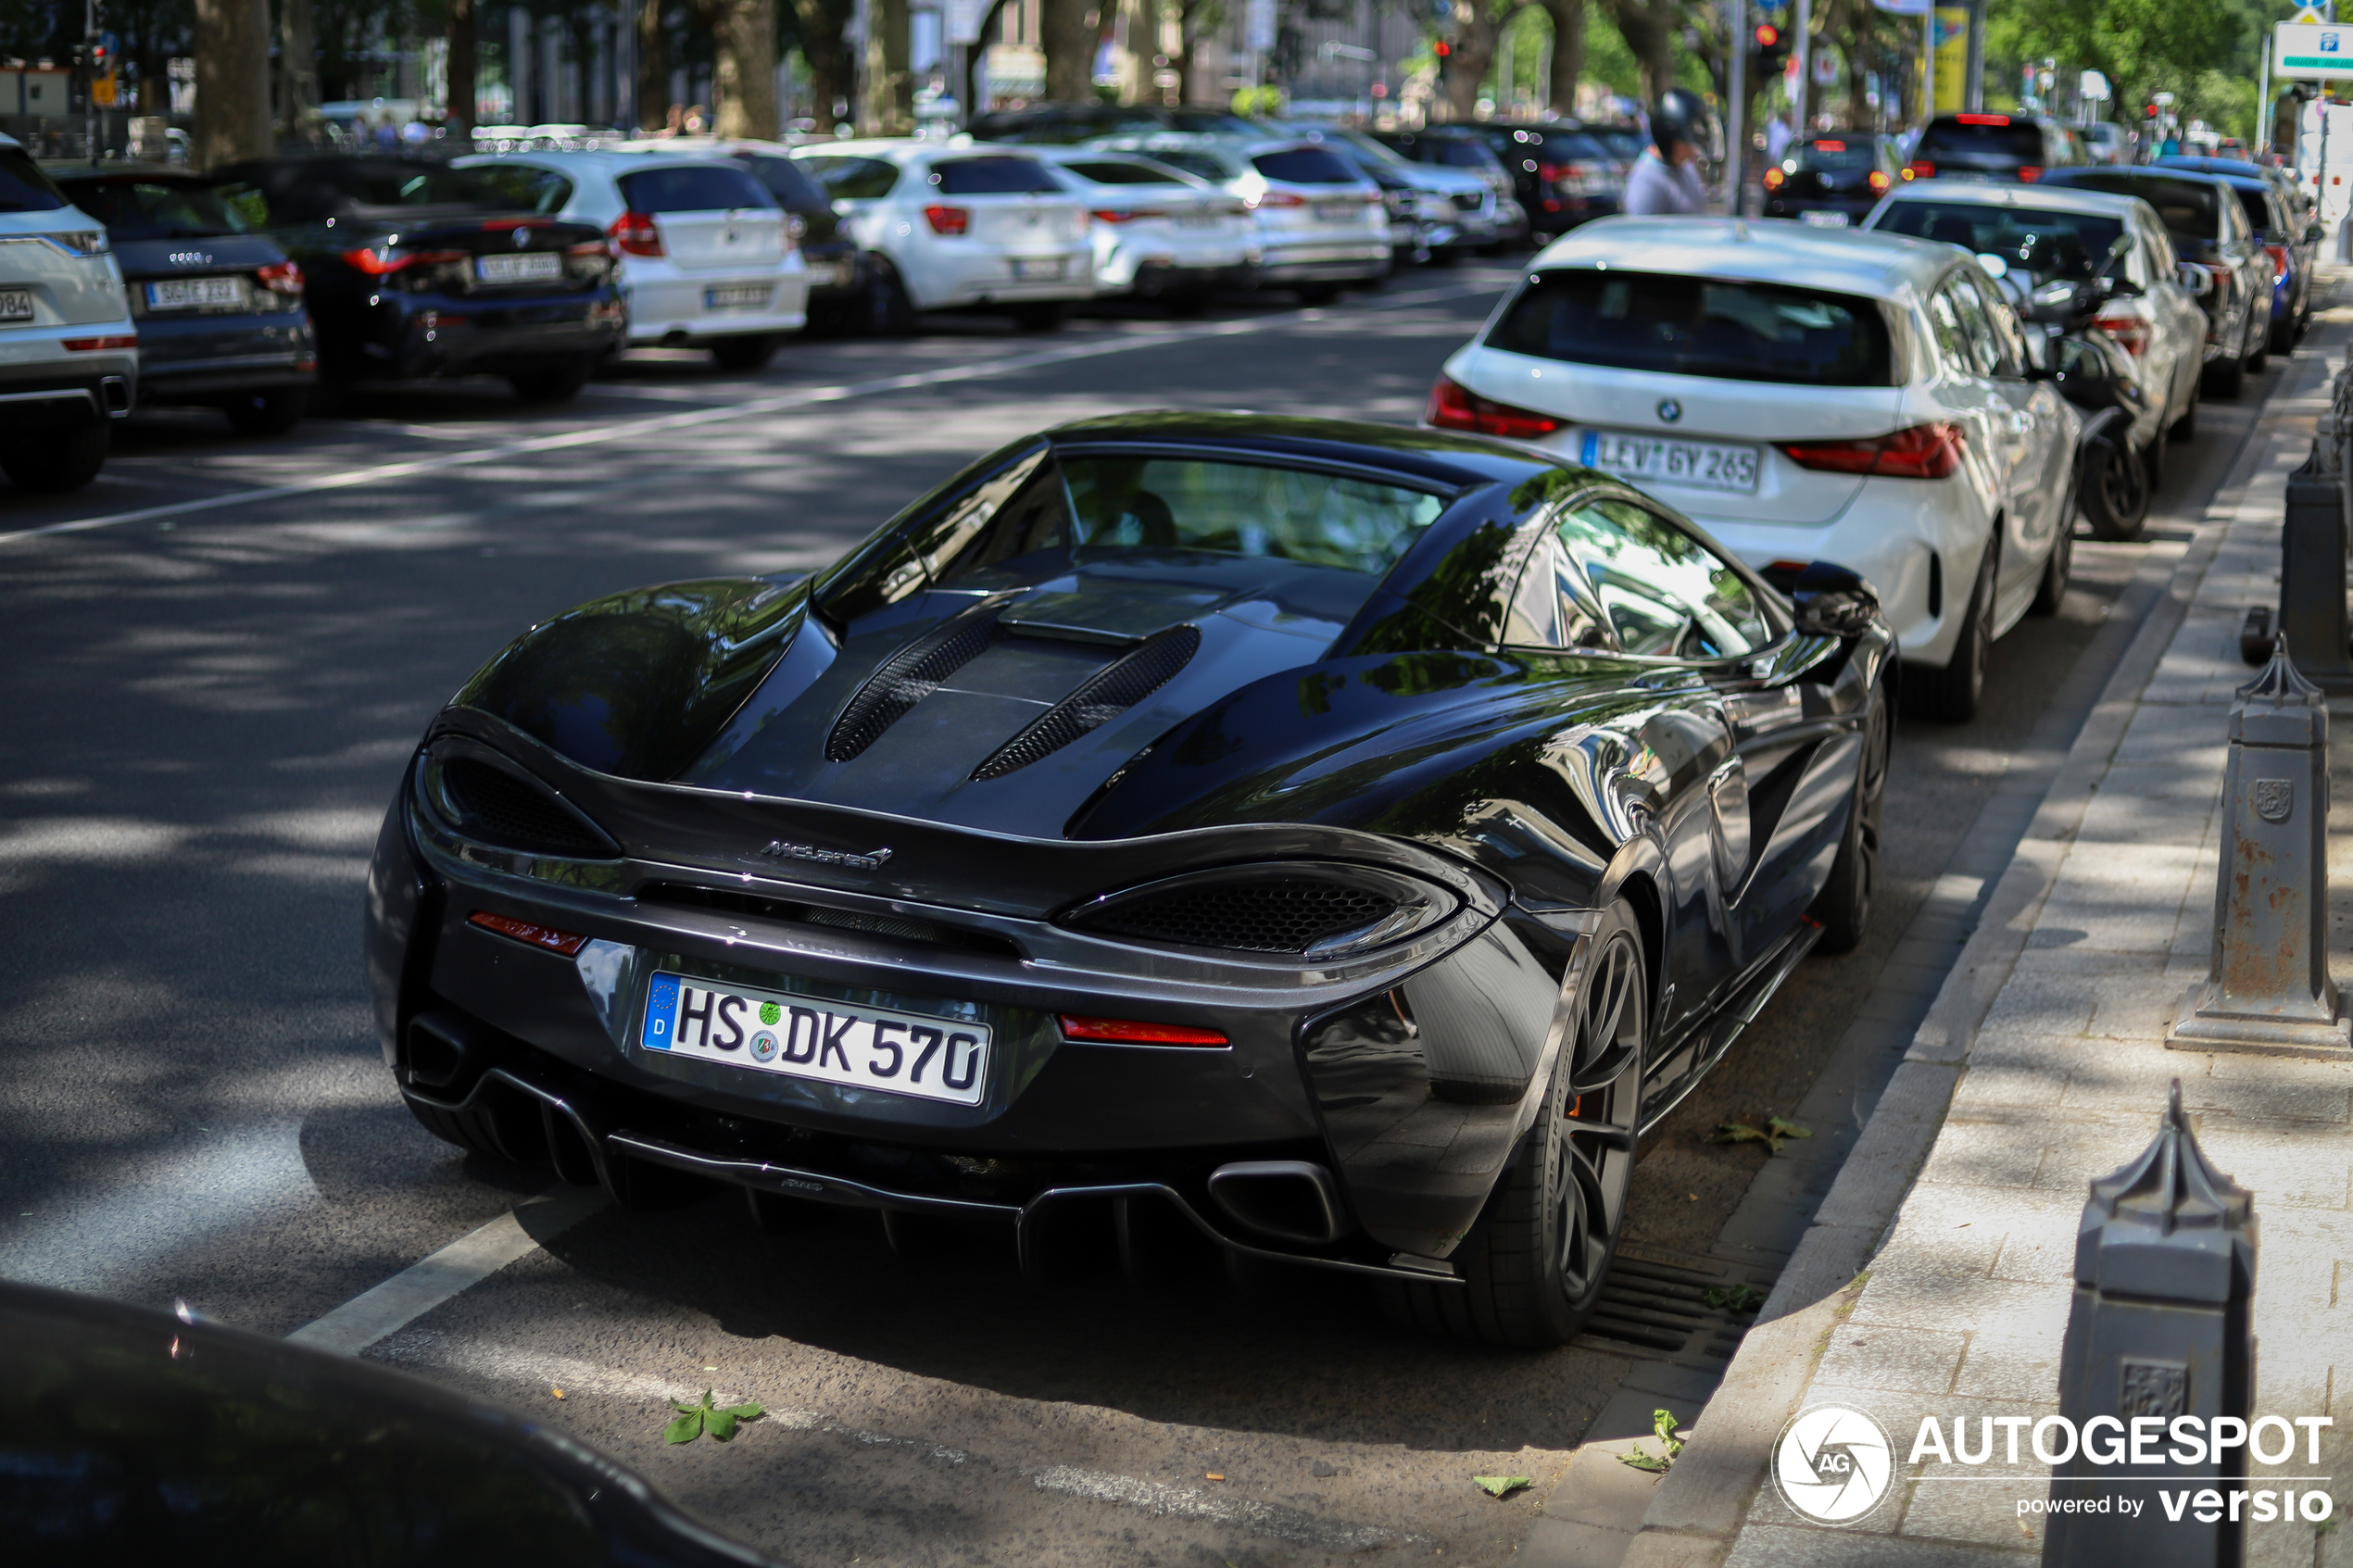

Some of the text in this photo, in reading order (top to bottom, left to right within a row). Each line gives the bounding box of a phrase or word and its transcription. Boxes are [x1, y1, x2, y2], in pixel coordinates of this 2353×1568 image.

[1601, 439, 1755, 482] LEV GY 265
[761, 840, 878, 871] McLaren
[653, 1019, 665, 1035] D
[677, 986, 979, 1090] HS DK 570
[1552, 1087, 1562, 1152] ZR20
